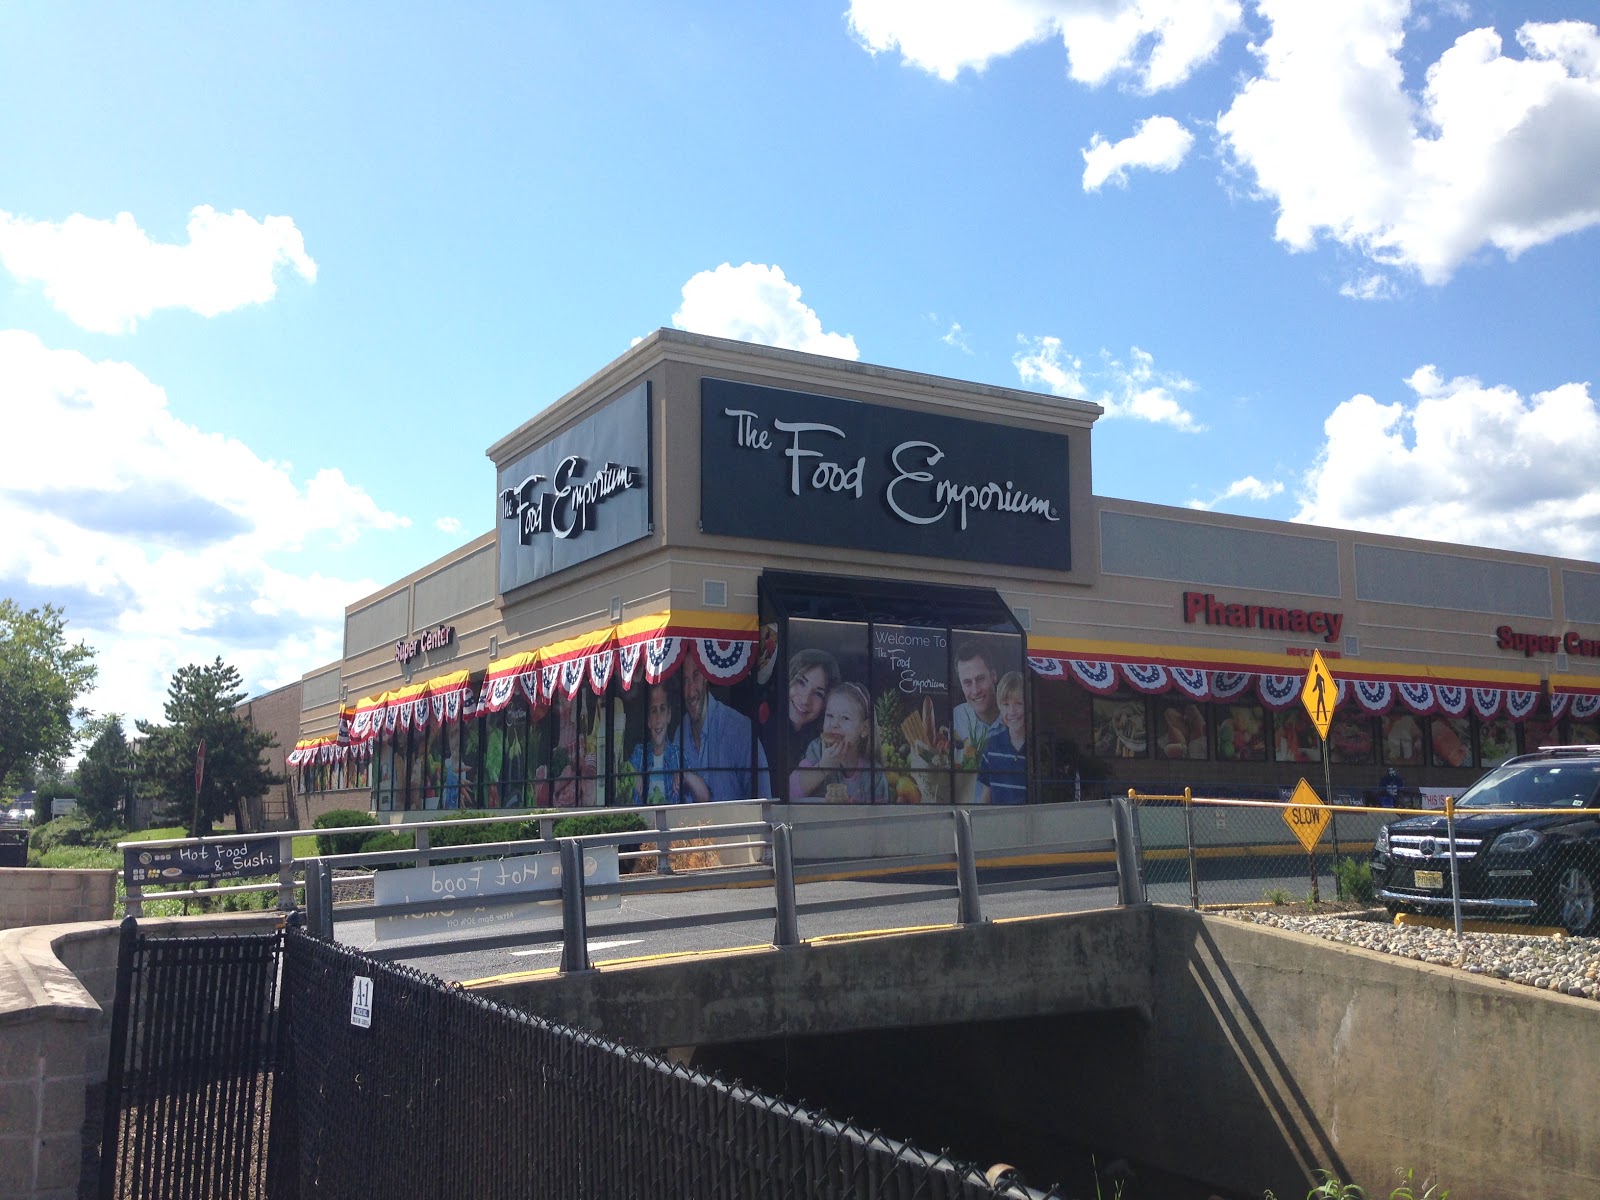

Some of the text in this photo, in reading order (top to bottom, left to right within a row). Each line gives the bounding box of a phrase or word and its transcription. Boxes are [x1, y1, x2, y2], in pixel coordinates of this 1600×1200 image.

[725, 407, 1060, 530] The Food Emporium
[499, 455, 636, 545] The Food Emporium
[1183, 591, 1343, 643] Pharmacy
[395, 626, 452, 664] Super Center
[875, 631, 947, 648] Welcome To
[1496, 625, 1561, 657] Super
[875, 647, 911, 670] The Food
[899, 669, 947, 693] Emporium
[1292, 808, 1320, 825] SLOW
[180, 843, 248, 861] Hot Food
[214, 852, 273, 871] & Sushi
